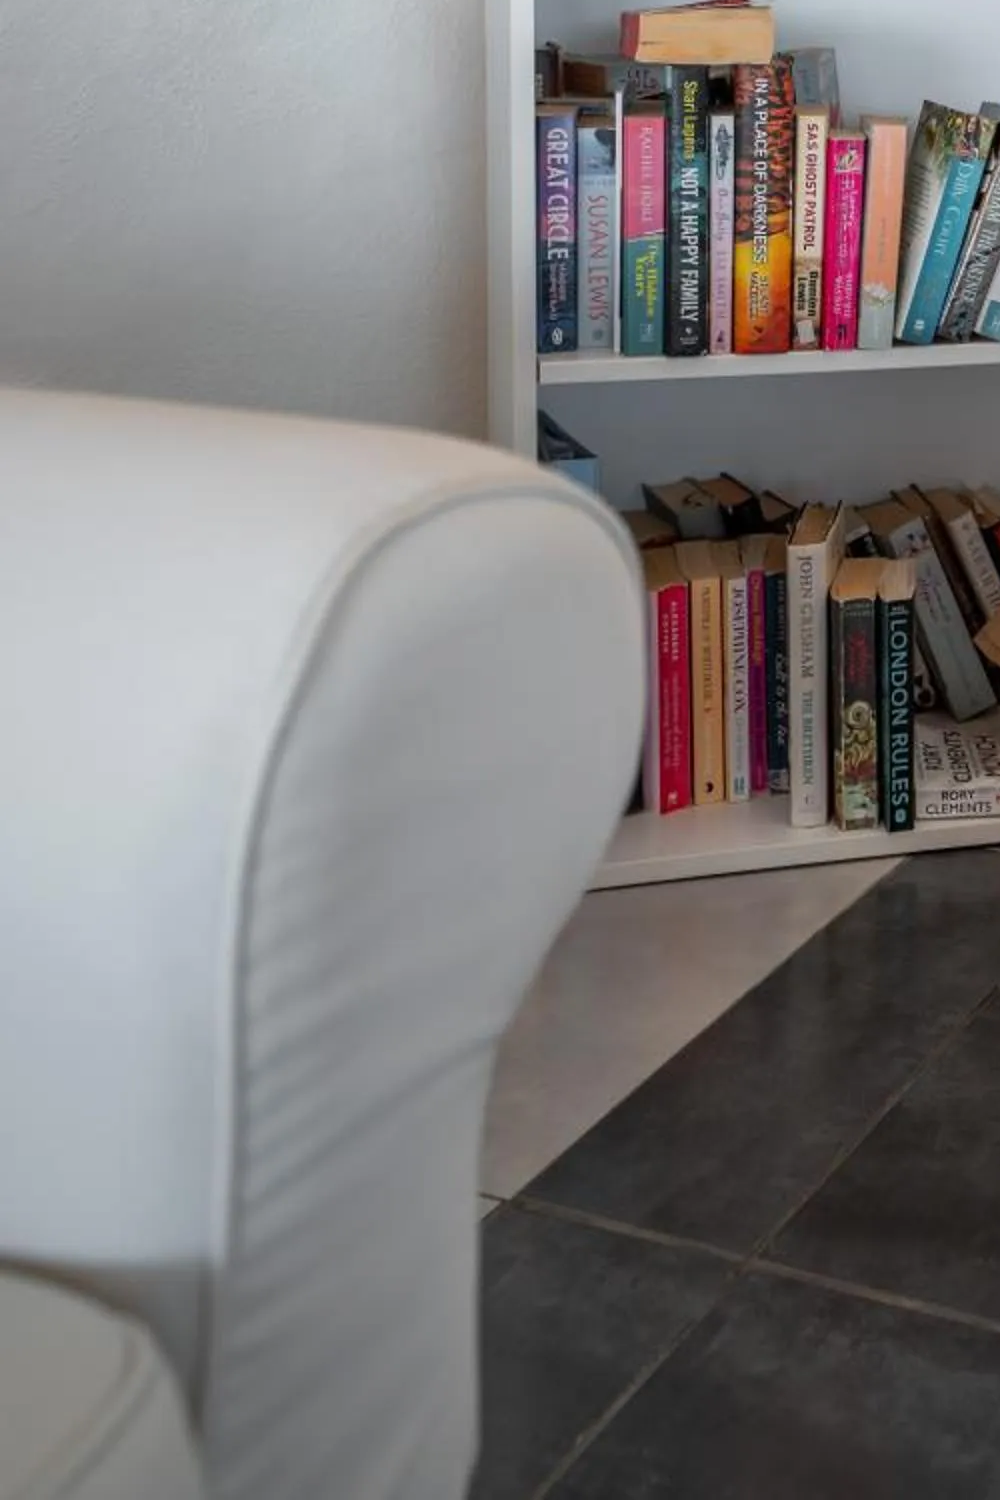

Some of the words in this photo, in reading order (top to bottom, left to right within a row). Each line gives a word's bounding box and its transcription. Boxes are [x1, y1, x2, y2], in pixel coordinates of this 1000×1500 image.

[682, 79, 700, 114] Shari
[754, 77, 768, 92] IN
[754, 97, 768, 108] A
[640, 126, 653, 180] RACHEL
[681, 116, 699, 160] Lapena
[753, 110, 768, 157] PLACE
[805, 122, 818, 151] SAS
[546, 127, 569, 192] GREAT
[681, 166, 698, 197] NOT
[753, 161, 767, 180] OF
[804, 153, 817, 197] GHOST
[952, 163, 974, 199] Dilly
[588, 194, 608, 259] SUSAN
[641, 185, 654, 223] HORE
[681, 199, 698, 213] A
[752, 183, 767, 264] DARKNESS
[802, 200, 816, 251] PATROL
[546, 194, 569, 261] CIRCLE
[680, 216, 698, 266] HAPPY
[933, 205, 959, 257] Court
[589, 265, 608, 321] LEWIS
[635, 254, 647, 297] Years
[680, 269, 698, 323] FAMILY
[796, 276, 808, 311] Lewis
[962, 253, 990, 304] PARTNER
[797, 555, 814, 600] JOHN
[732, 587, 748, 675] JOSEPHINE
[799, 603, 815, 680] GRISHAM
[889, 619, 909, 726] LONDON
[733, 678, 748, 715] COX
[802, 690, 814, 714] THE
[801, 716, 814, 786] BRETHREN
[890, 732, 909, 807] RULES
[921, 741, 944, 772] RORY
[943, 730, 973, 784] CLEMENTS
[925, 801, 993, 816] CLEMENTS
[941, 789, 976, 801] RORY
